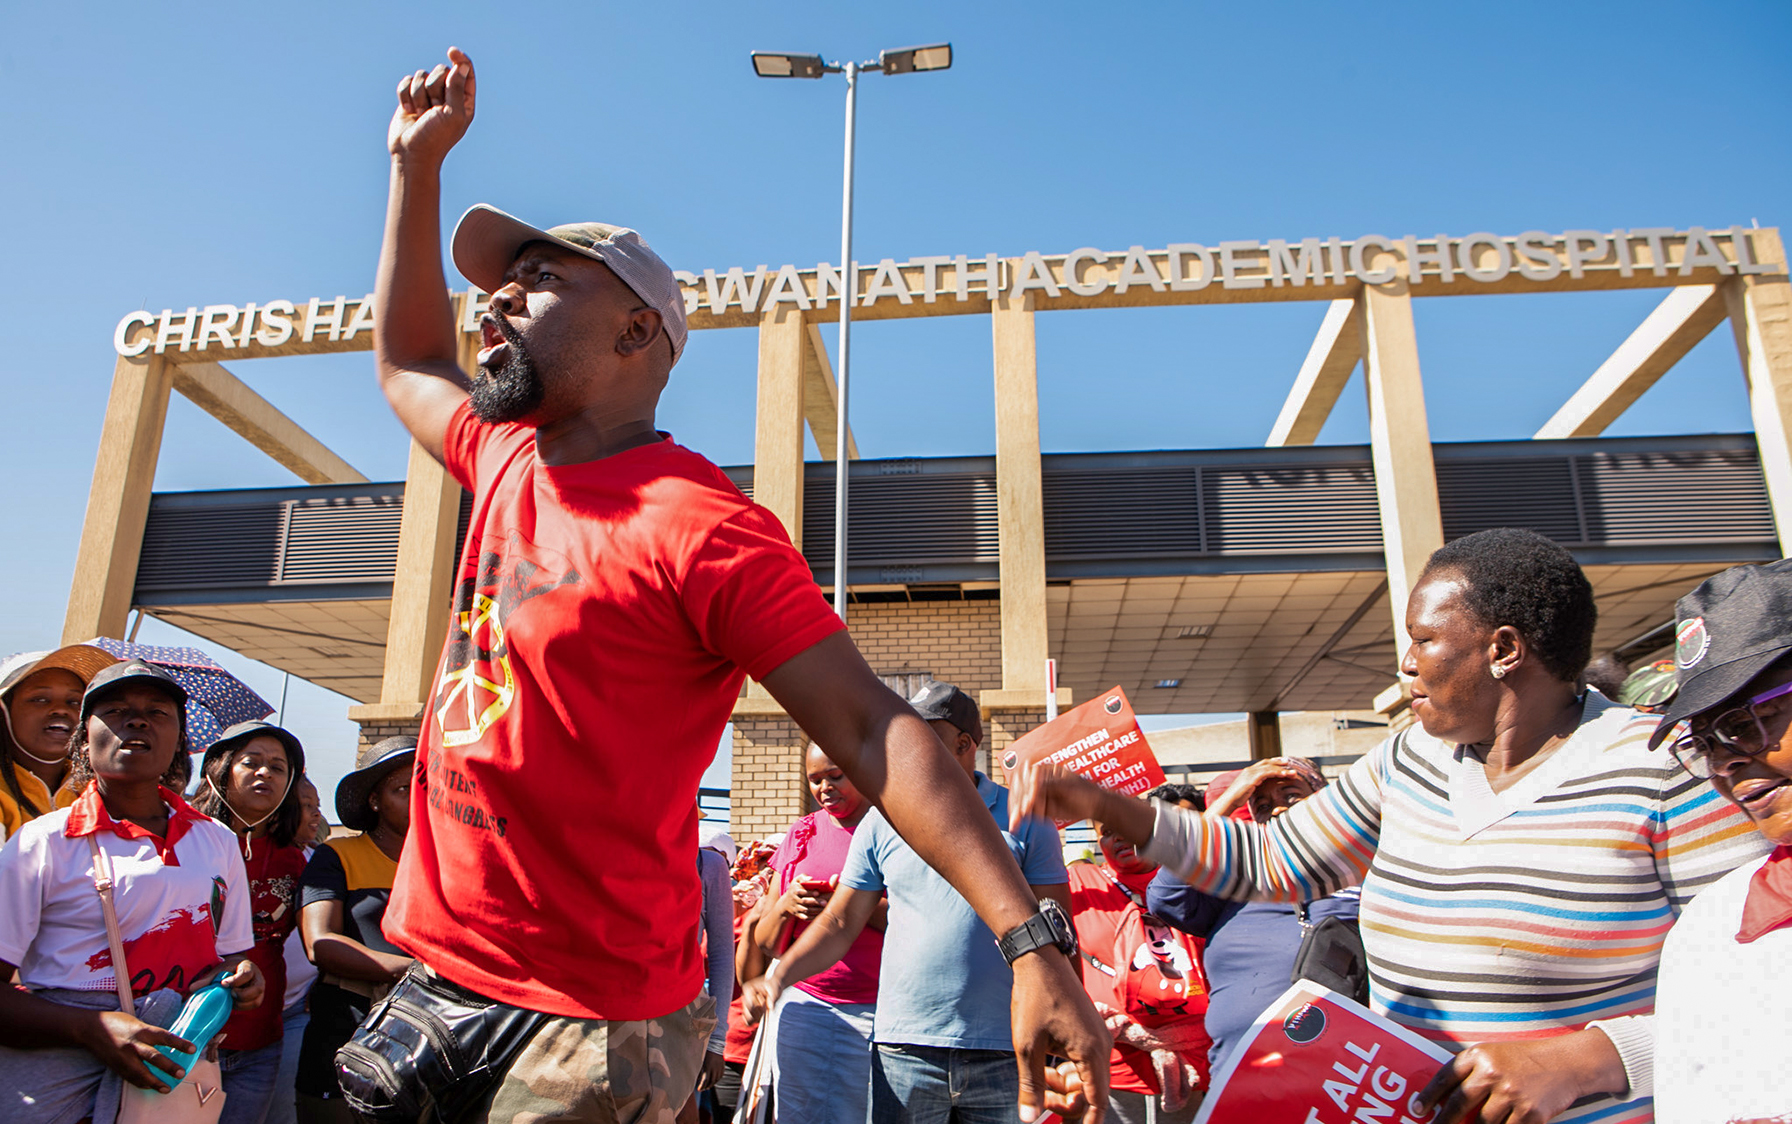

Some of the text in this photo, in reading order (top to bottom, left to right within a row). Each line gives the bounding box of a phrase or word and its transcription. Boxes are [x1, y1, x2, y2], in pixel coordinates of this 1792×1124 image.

[114, 300, 295, 357] CHRIS
[1009, 233, 1399, 298] ACADEMIC
[1404, 225, 1779, 285] HOSPITAL
[1093, 757, 1121, 777] FOR
[1097, 761, 1146, 790] HEALTH
[1322, 1041, 1381, 1114] ALL
